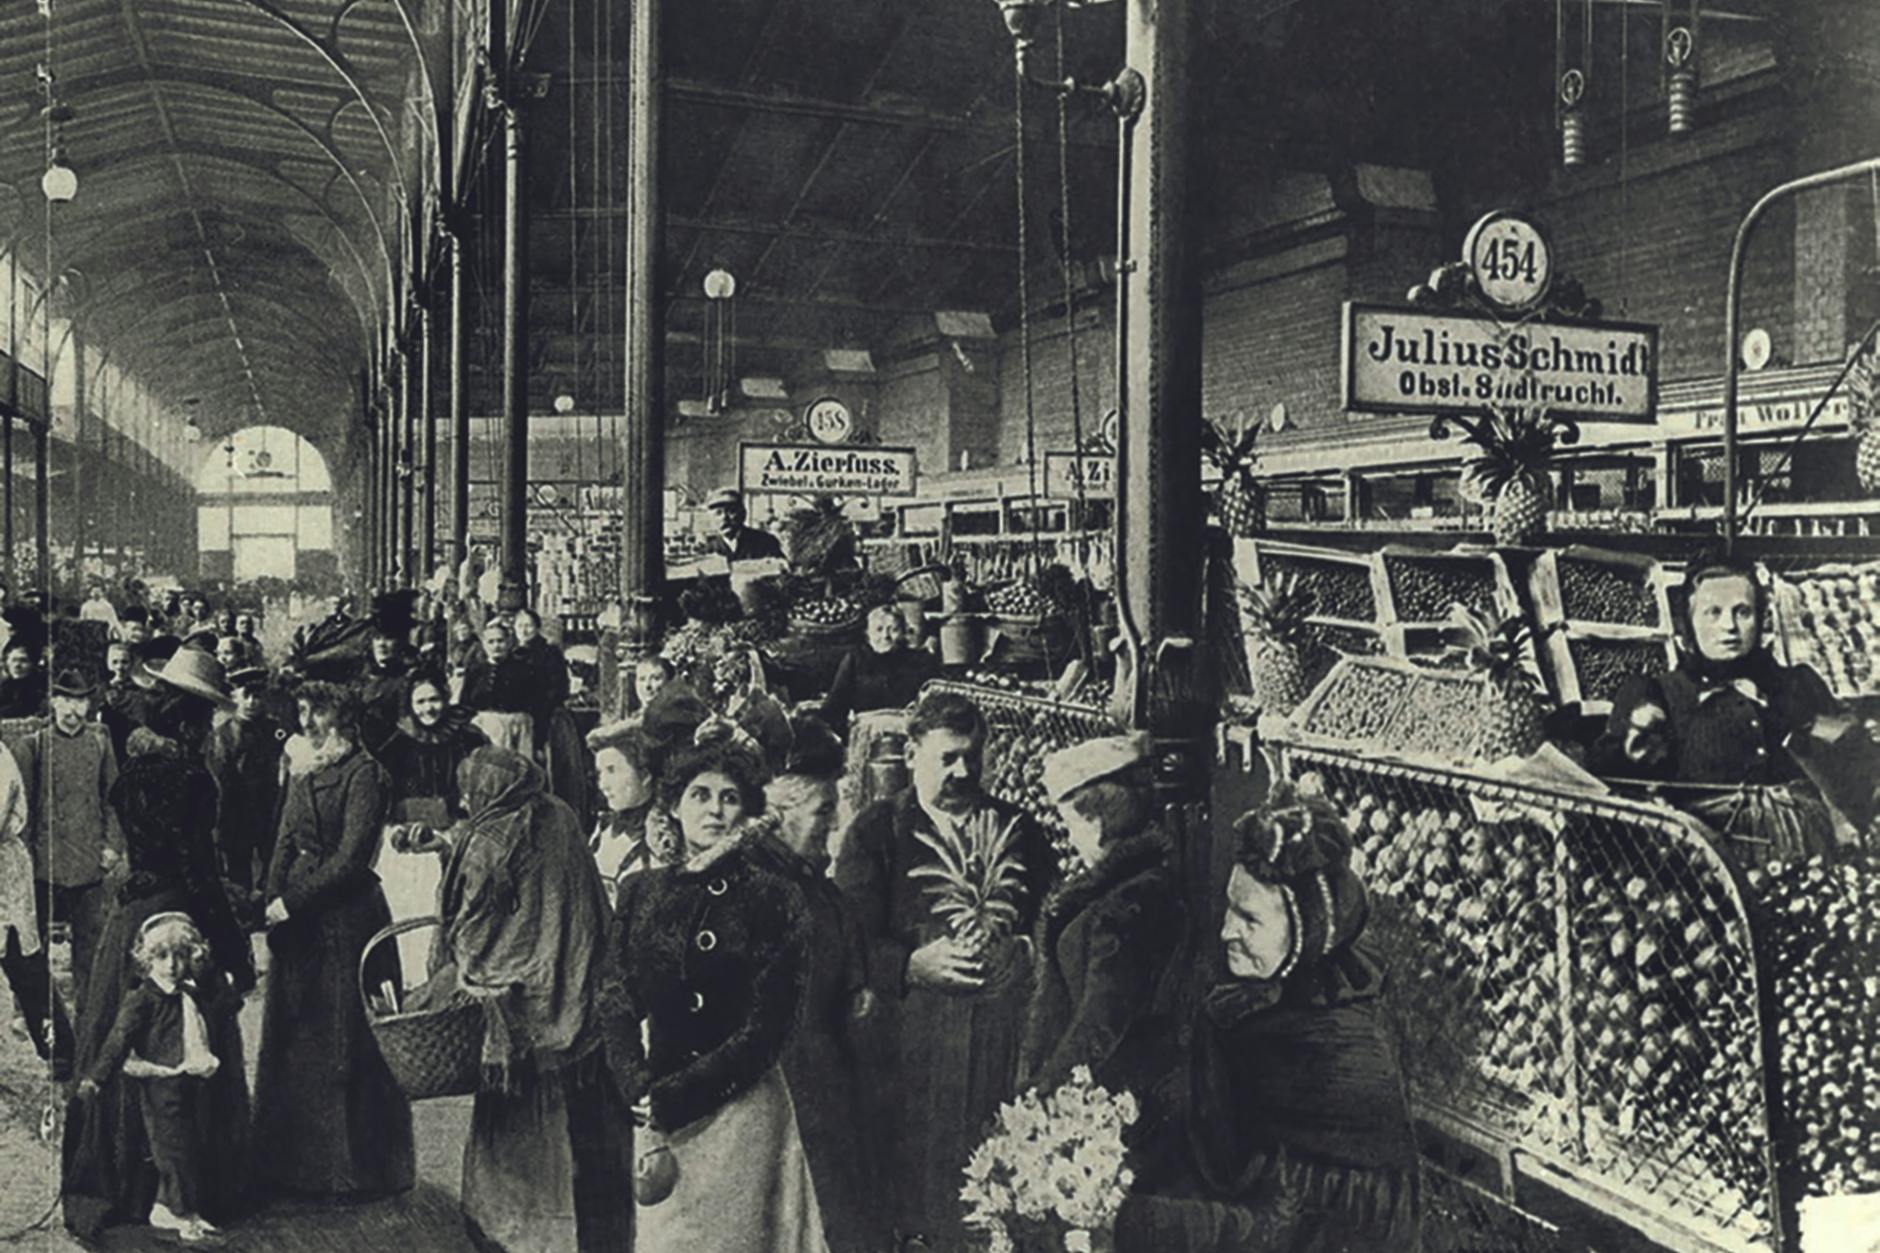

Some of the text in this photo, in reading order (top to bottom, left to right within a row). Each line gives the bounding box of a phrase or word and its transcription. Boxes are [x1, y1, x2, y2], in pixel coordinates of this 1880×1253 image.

[1481, 237, 1537, 284] 454
[1368, 325, 1649, 377] Julius Schmidt
[1399, 371, 1471, 398] Obst.
